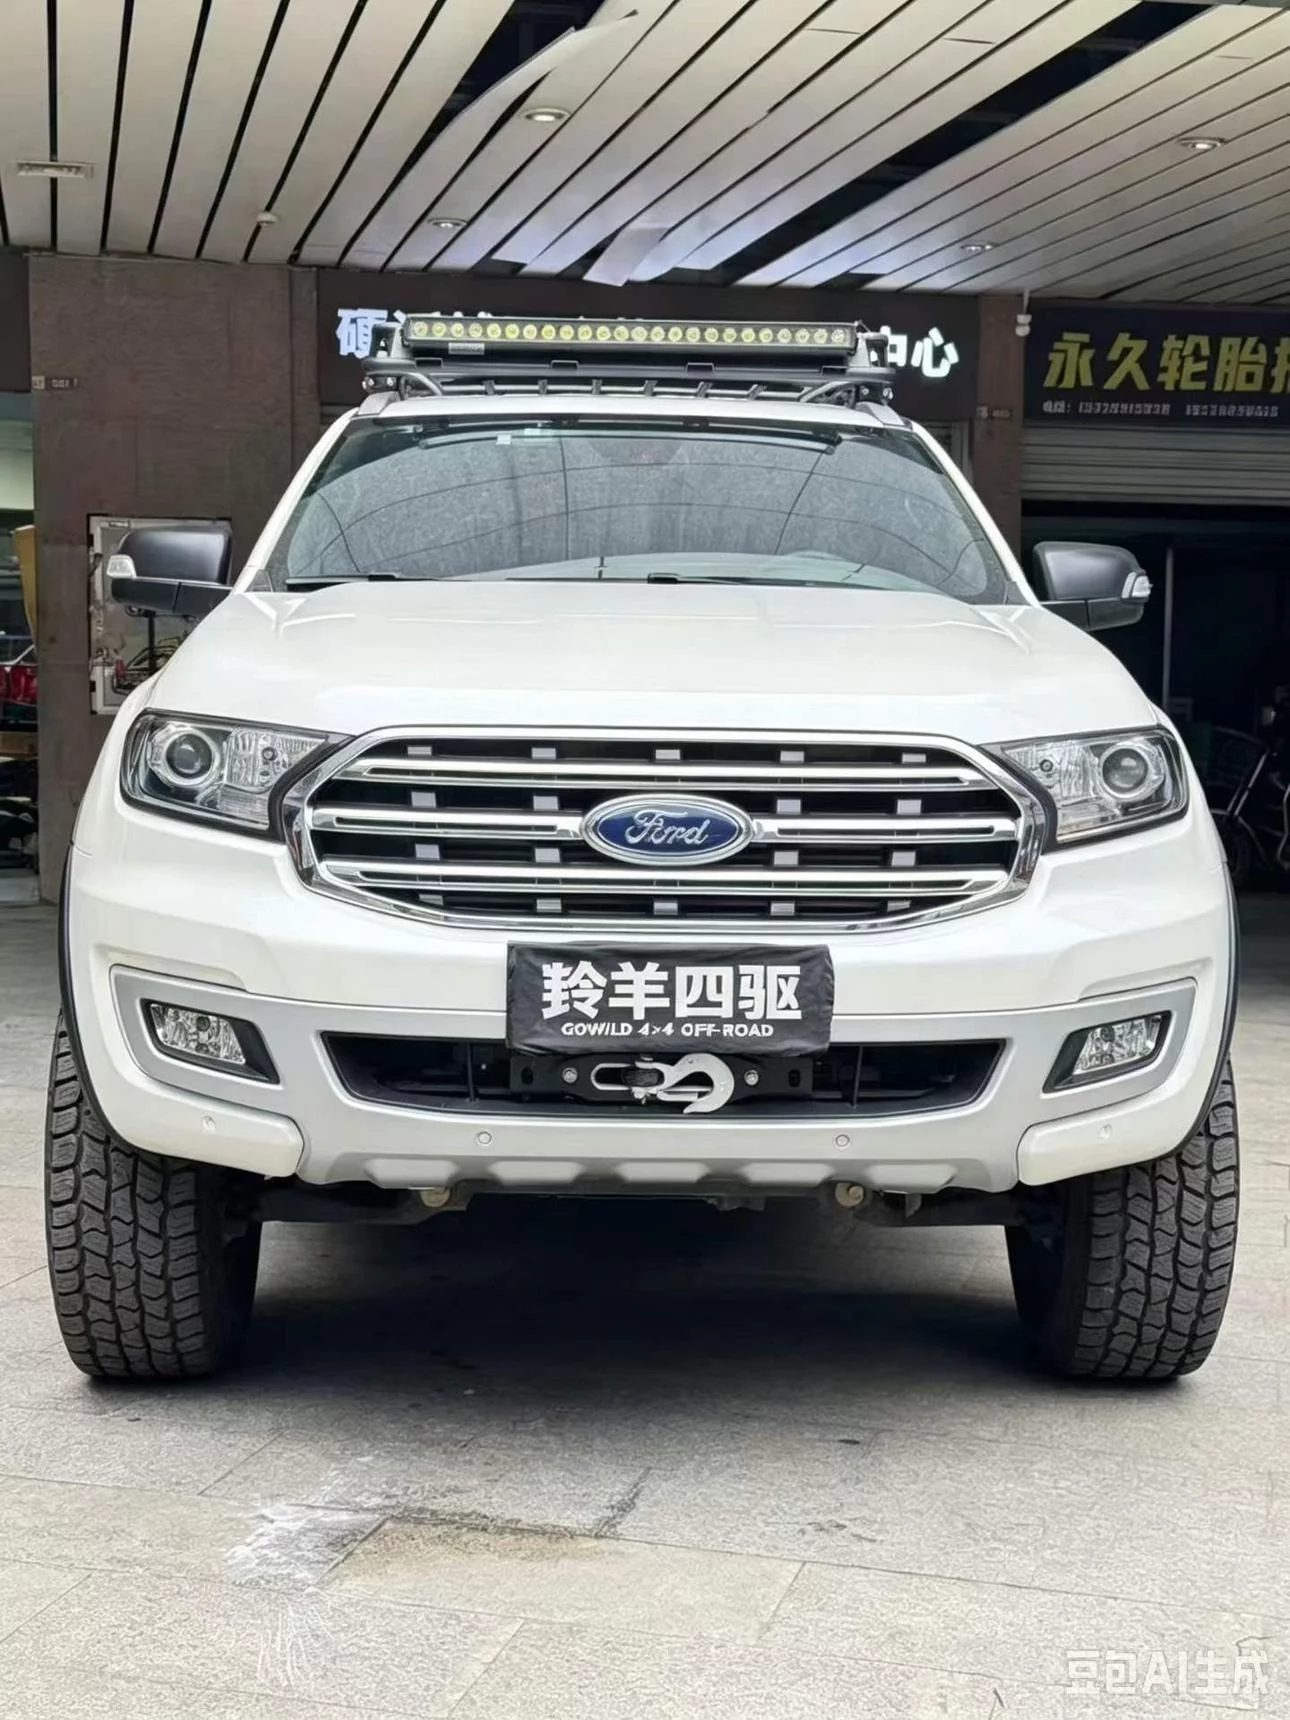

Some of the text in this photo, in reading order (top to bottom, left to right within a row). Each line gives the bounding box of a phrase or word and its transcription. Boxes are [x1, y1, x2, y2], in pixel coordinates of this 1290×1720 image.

[625, 809, 711, 845] Ford
[541, 960, 803, 1021] 羚羊四驱
[561, 1022, 633, 1037] GOWILD
[681, 1022, 774, 1038] OFF-ROAD
